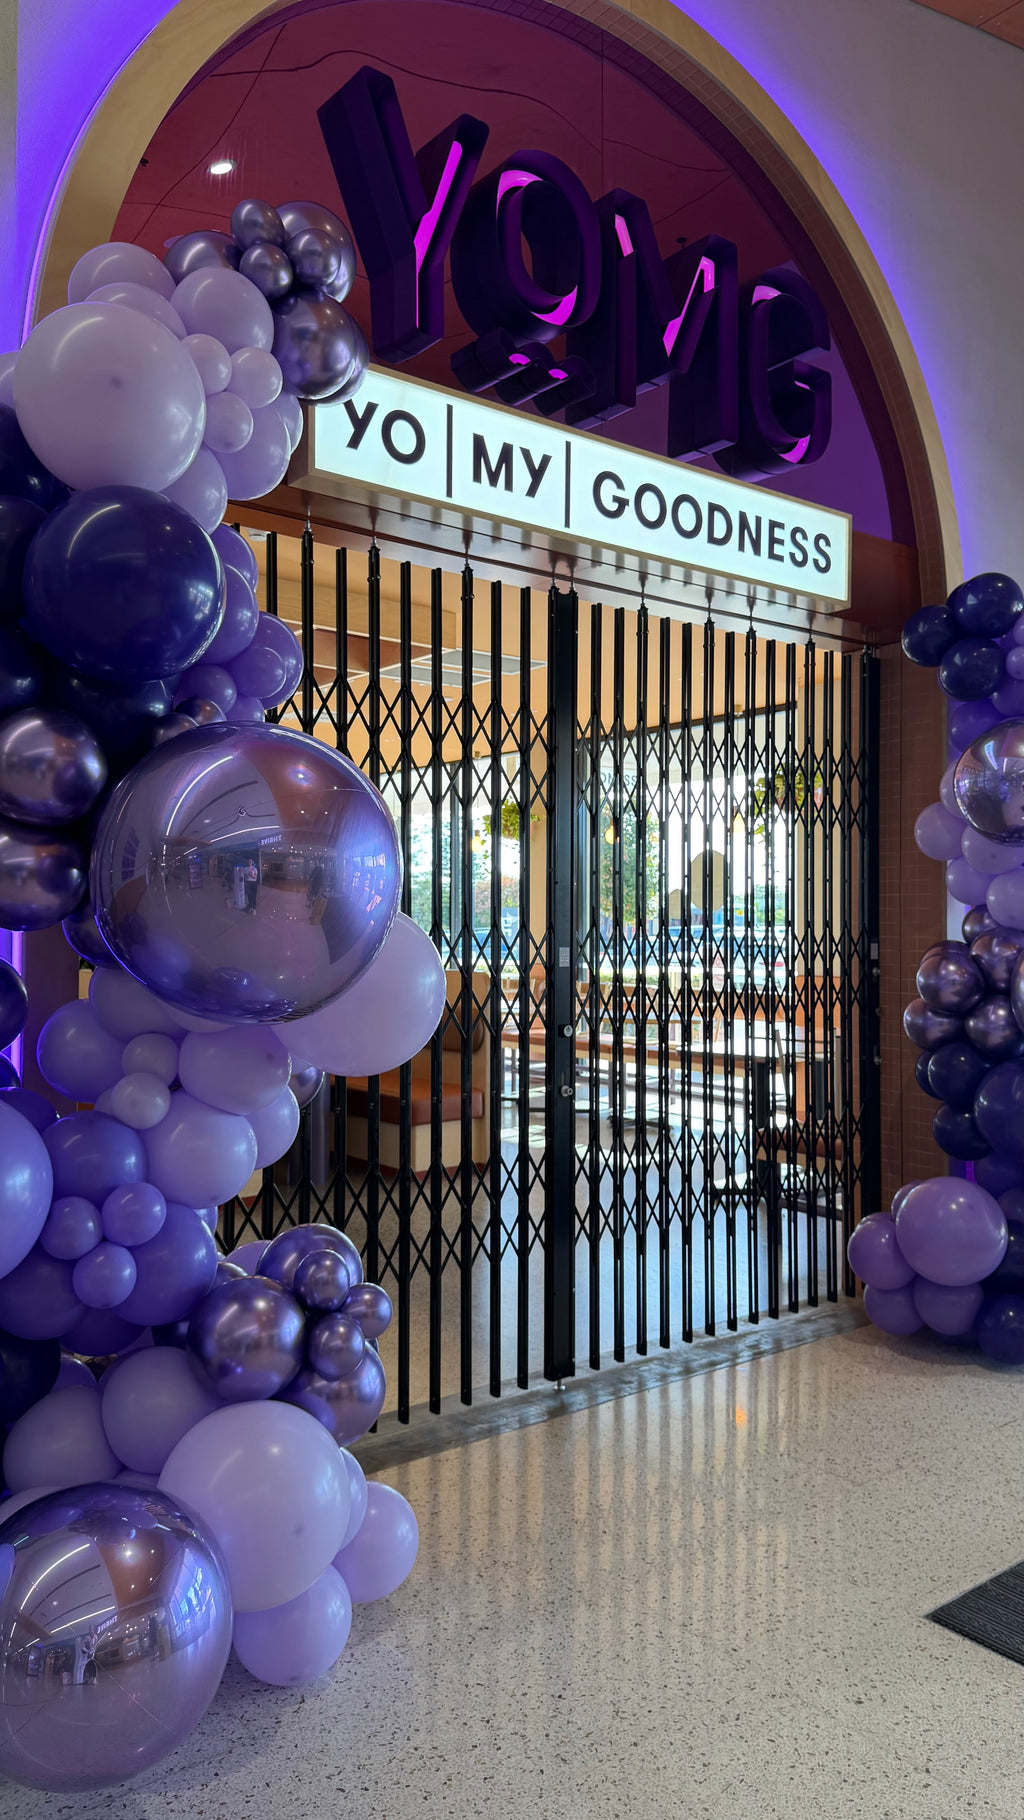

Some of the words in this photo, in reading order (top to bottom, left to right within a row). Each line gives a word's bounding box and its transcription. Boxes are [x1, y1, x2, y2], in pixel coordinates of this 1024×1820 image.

[316, 65, 834, 483] YOMG
[343, 399, 426, 465] YO
[472, 432, 552, 498] MY
[592, 470, 832, 574] GOODNESS
